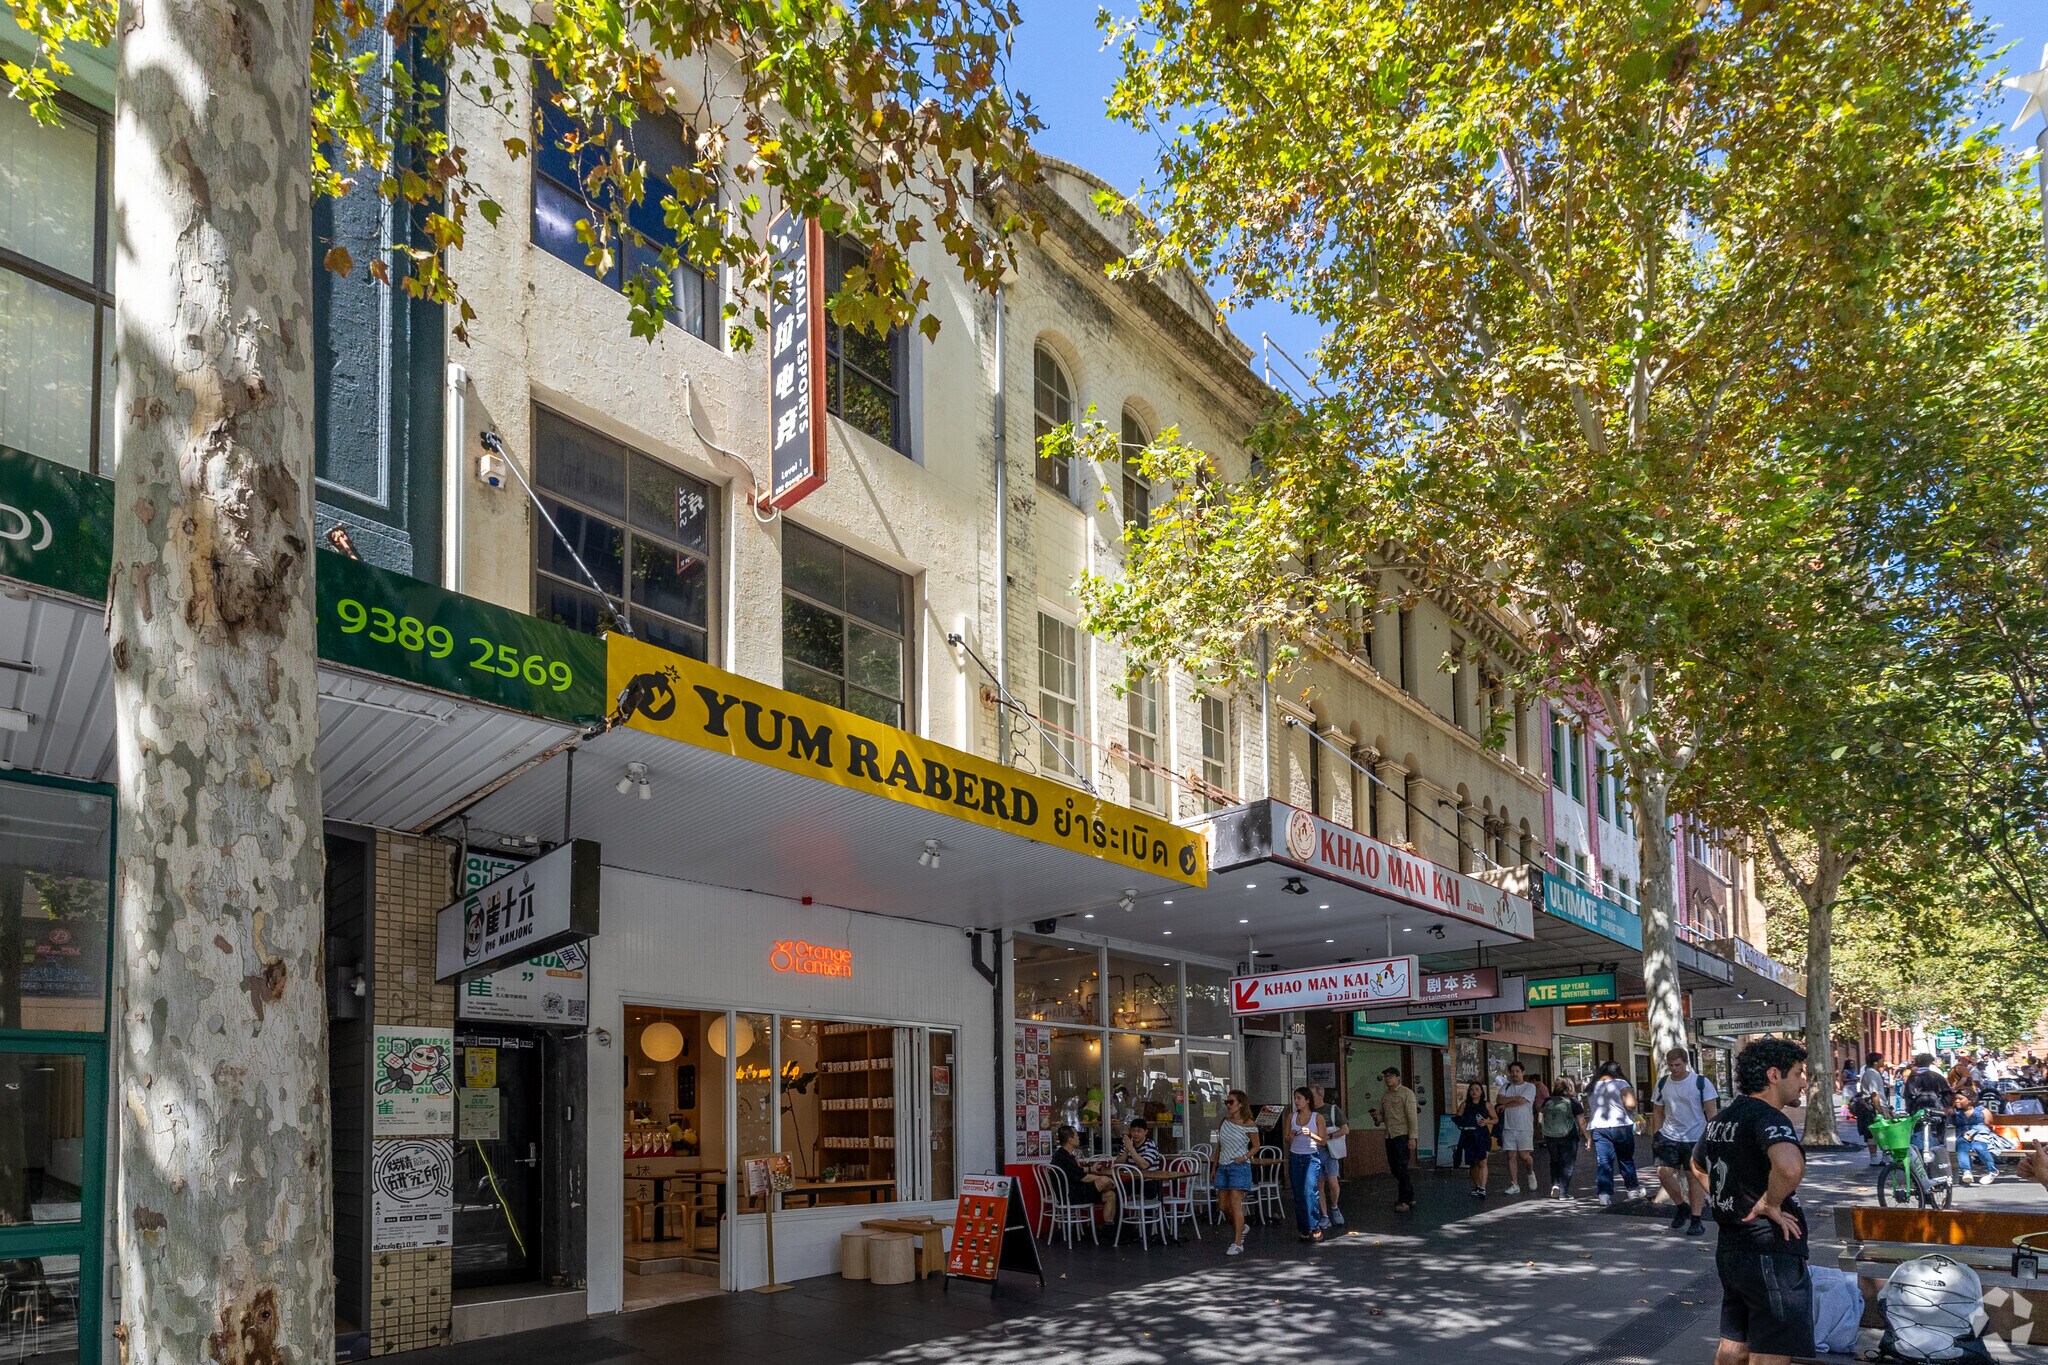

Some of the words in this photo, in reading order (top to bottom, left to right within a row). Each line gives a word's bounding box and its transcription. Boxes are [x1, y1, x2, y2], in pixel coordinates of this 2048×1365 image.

[796, 254, 807, 329] KOALA
[797, 338, 809, 434] ESPORTS
[781, 461, 798, 480] Level
[799, 457, 803, 467] 1
[336, 598, 455, 660] 9389
[468, 636, 574, 693] 2569
[693, 685, 834, 769] YUM
[847, 734, 1039, 827] RABERD
[1054, 797, 1169, 867] ยำระเบิด
[1321, 827, 1380, 881] KHAO
[1388, 852, 1427, 897] MAN
[1433, 870, 1461, 907] KAI
[1549, 880, 1598, 926] ULTIMATE
[485, 939, 496, 954] Q16
[499, 922, 534, 946] MAHJONG
[795, 941, 852, 964] Orange
[795, 957, 852, 979] Lantern
[1264, 980, 1302, 996] KHAO
[1308, 976, 1338, 992] MAN
[1344, 972, 1369, 988] KAI
[1427, 973, 1477, 993] 剧本杀
[1528, 984, 1558, 1001] ATE
[1561, 983, 1571, 991] GAP
[1572, 982, 1585, 990] YEAR
[1561, 989, 1590, 998] ADVENTURE
[1591, 988, 1610, 996] TRAVEL
[1419, 992, 1458, 1002] tertainment
[1504, 1013, 1536, 1036] Kitchen
[376, 1098, 394, 1115] 雀
[1764, 1125, 1797, 1141] 22
[382, 1163, 441, 1191] 研究所
[635, 1164, 652, 1200] 抹茶
[984, 1180, 995, 1193] $4
